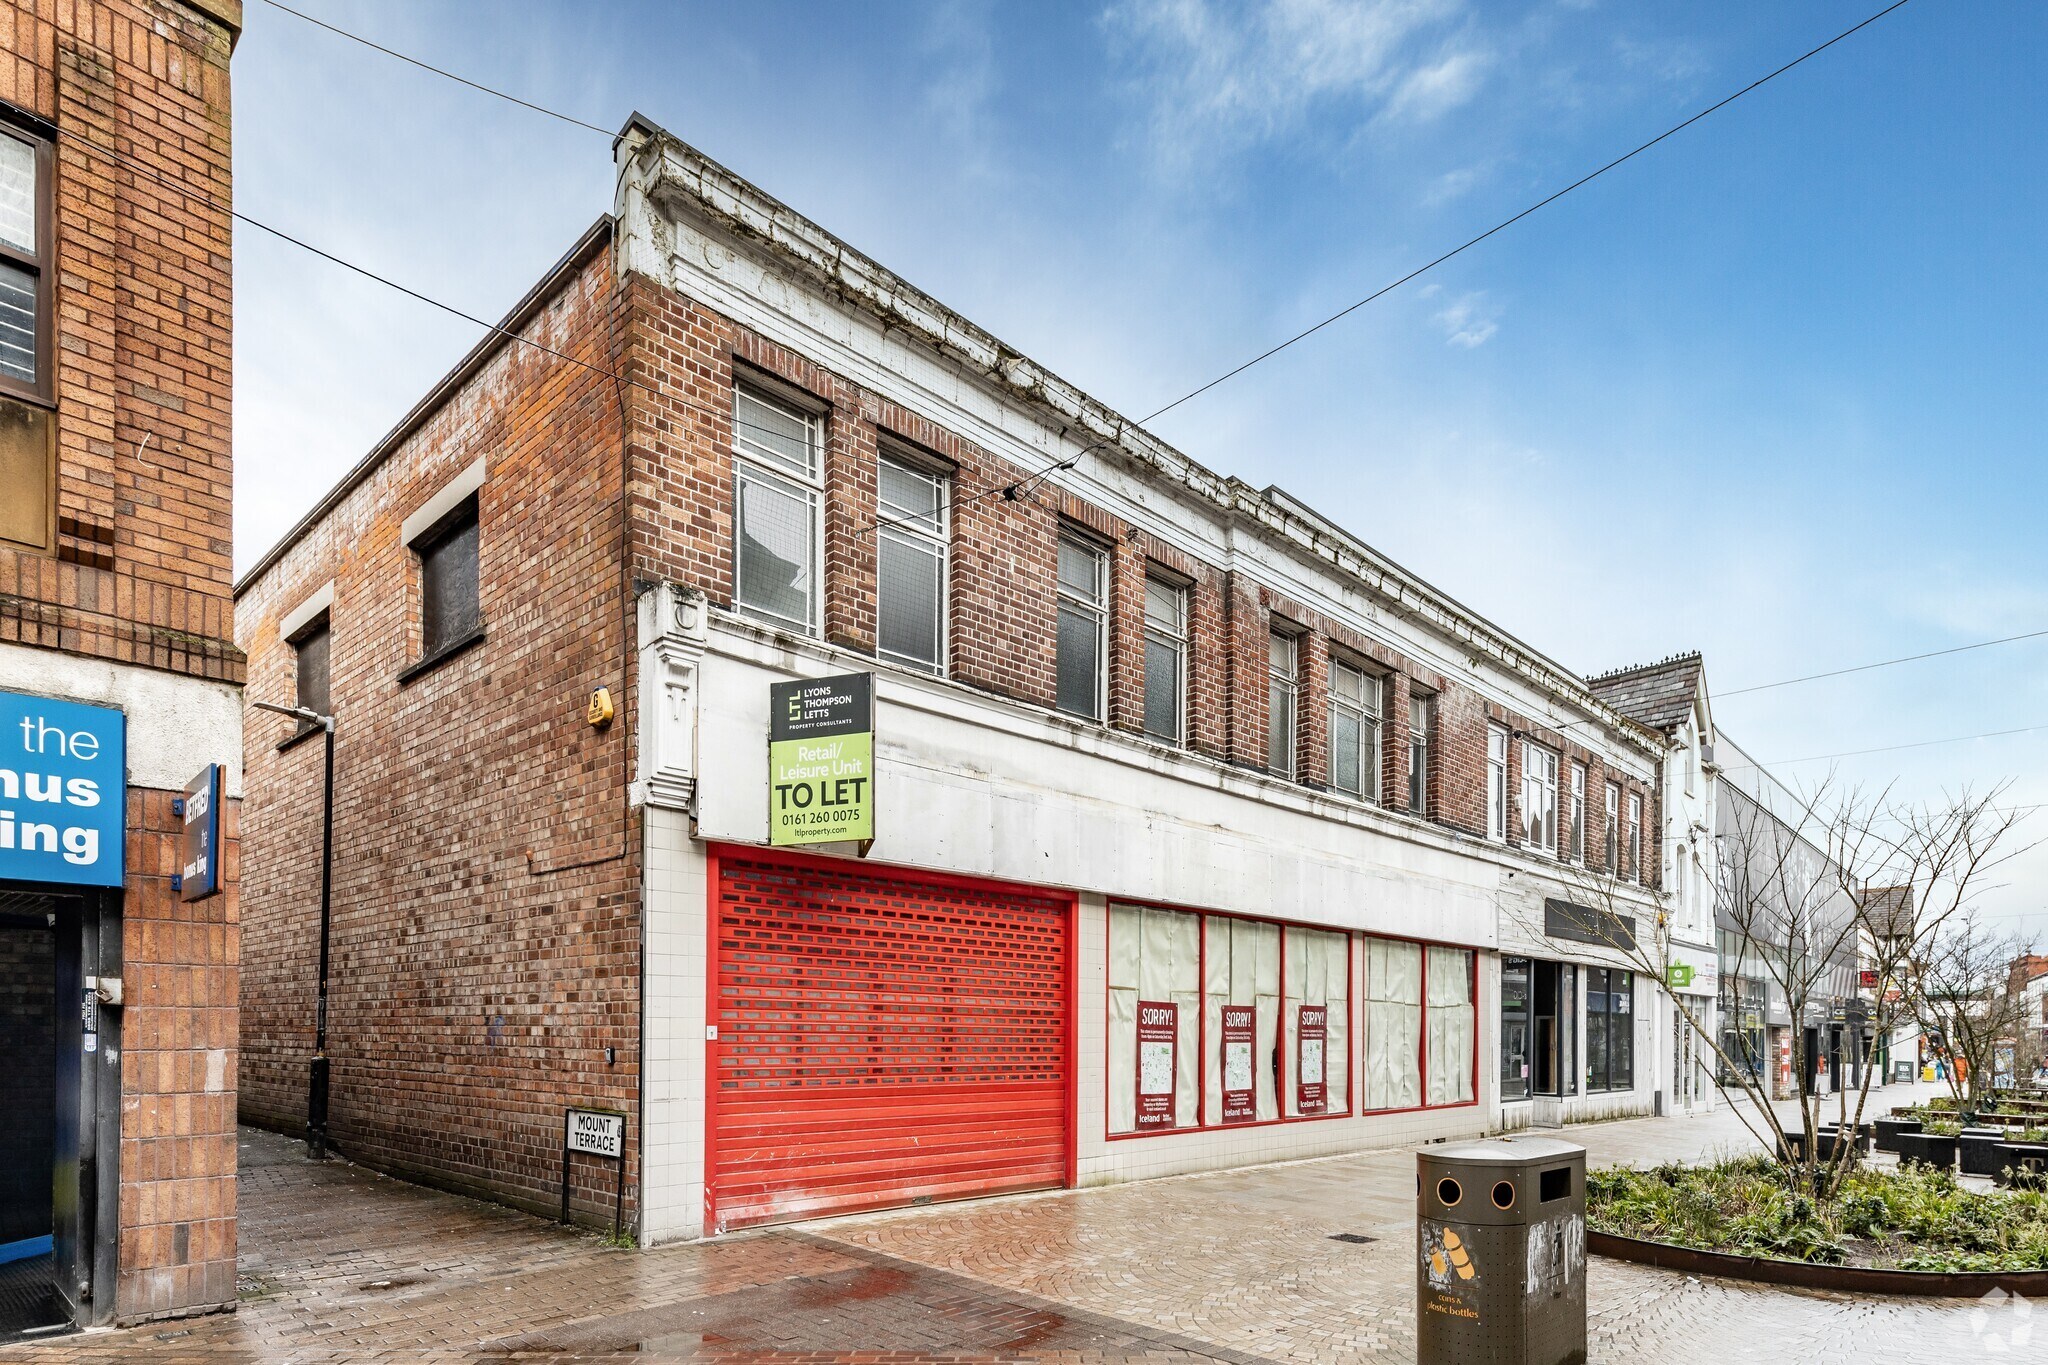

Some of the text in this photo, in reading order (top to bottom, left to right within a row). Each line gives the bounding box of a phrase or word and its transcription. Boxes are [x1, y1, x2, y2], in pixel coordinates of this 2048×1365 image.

[804, 686, 831, 697] LYONS
[804, 695, 852, 708] THOMPSON
[804, 708, 829, 719] LETTS
[816, 719, 852, 727] CONSULTANTS
[19, 716, 99, 760] the
[798, 742, 843, 762] Retail/
[780, 758, 862, 780] Leisure Unit
[775, 777, 867, 809] TO LET
[782, 809, 860, 826] 0161 260 0075
[794, 827, 847, 838] ltlproperty.com
[1142, 1008, 1173, 1026] SORRY!
[1226, 1012, 1251, 1027] SORRY!
[1302, 1011, 1325, 1026] SORRY!
[1139, 1114, 1160, 1123] Iceland
[1224, 1108, 1241, 1117] Iceland
[578, 1115, 611, 1134] MOUNT
[574, 1131, 615, 1152] TERRACE
[1438, 1294, 1456, 1303] cans
[1426, 1301, 1479, 1318] plastic bottles
